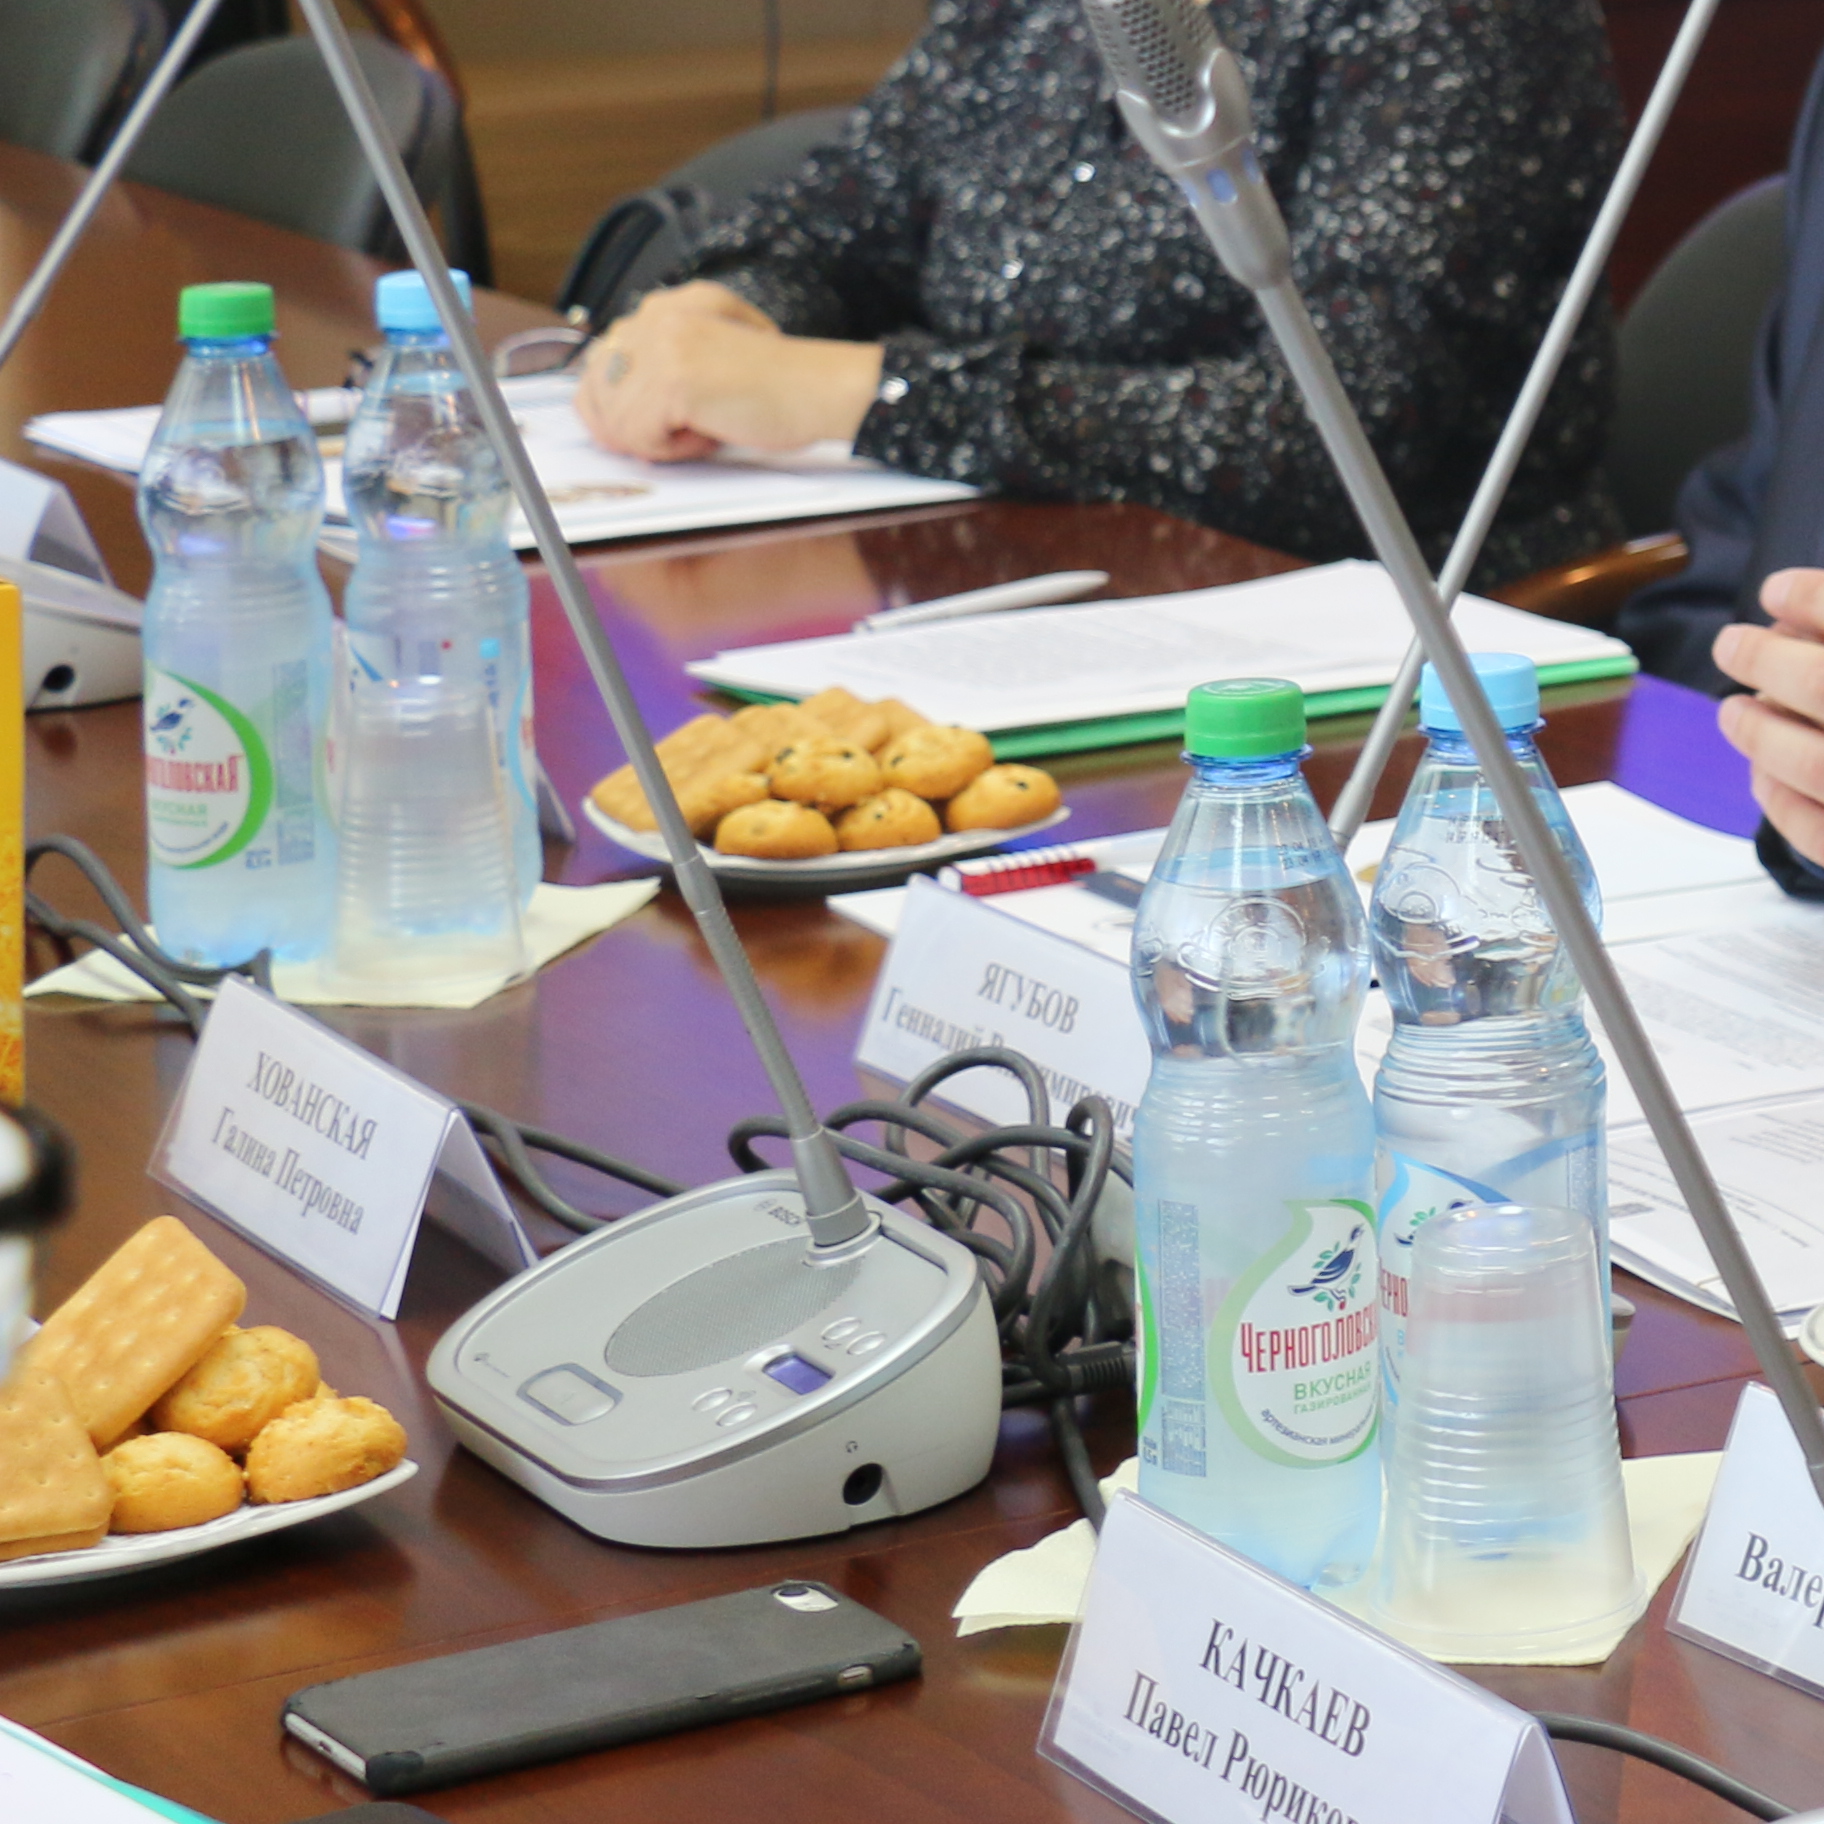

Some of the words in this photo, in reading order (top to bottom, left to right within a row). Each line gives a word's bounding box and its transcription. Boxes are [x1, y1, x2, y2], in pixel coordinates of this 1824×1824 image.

[977, 962, 1080, 1035] ЯГУБОВ
[246, 1050, 379, 1161] ХОВАНСКАЯ
[211, 1106, 277, 1178] Галина
[275, 1146, 365, 1236] Петровна
[1293, 1360, 1371, 1400] ВКУСНАЯ
[1122, 1669, 1219, 1771] Павел
[1219, 1727, 1360, 1824] Рюрик
[1198, 1616, 1372, 1758] КАЧКАЕВ
